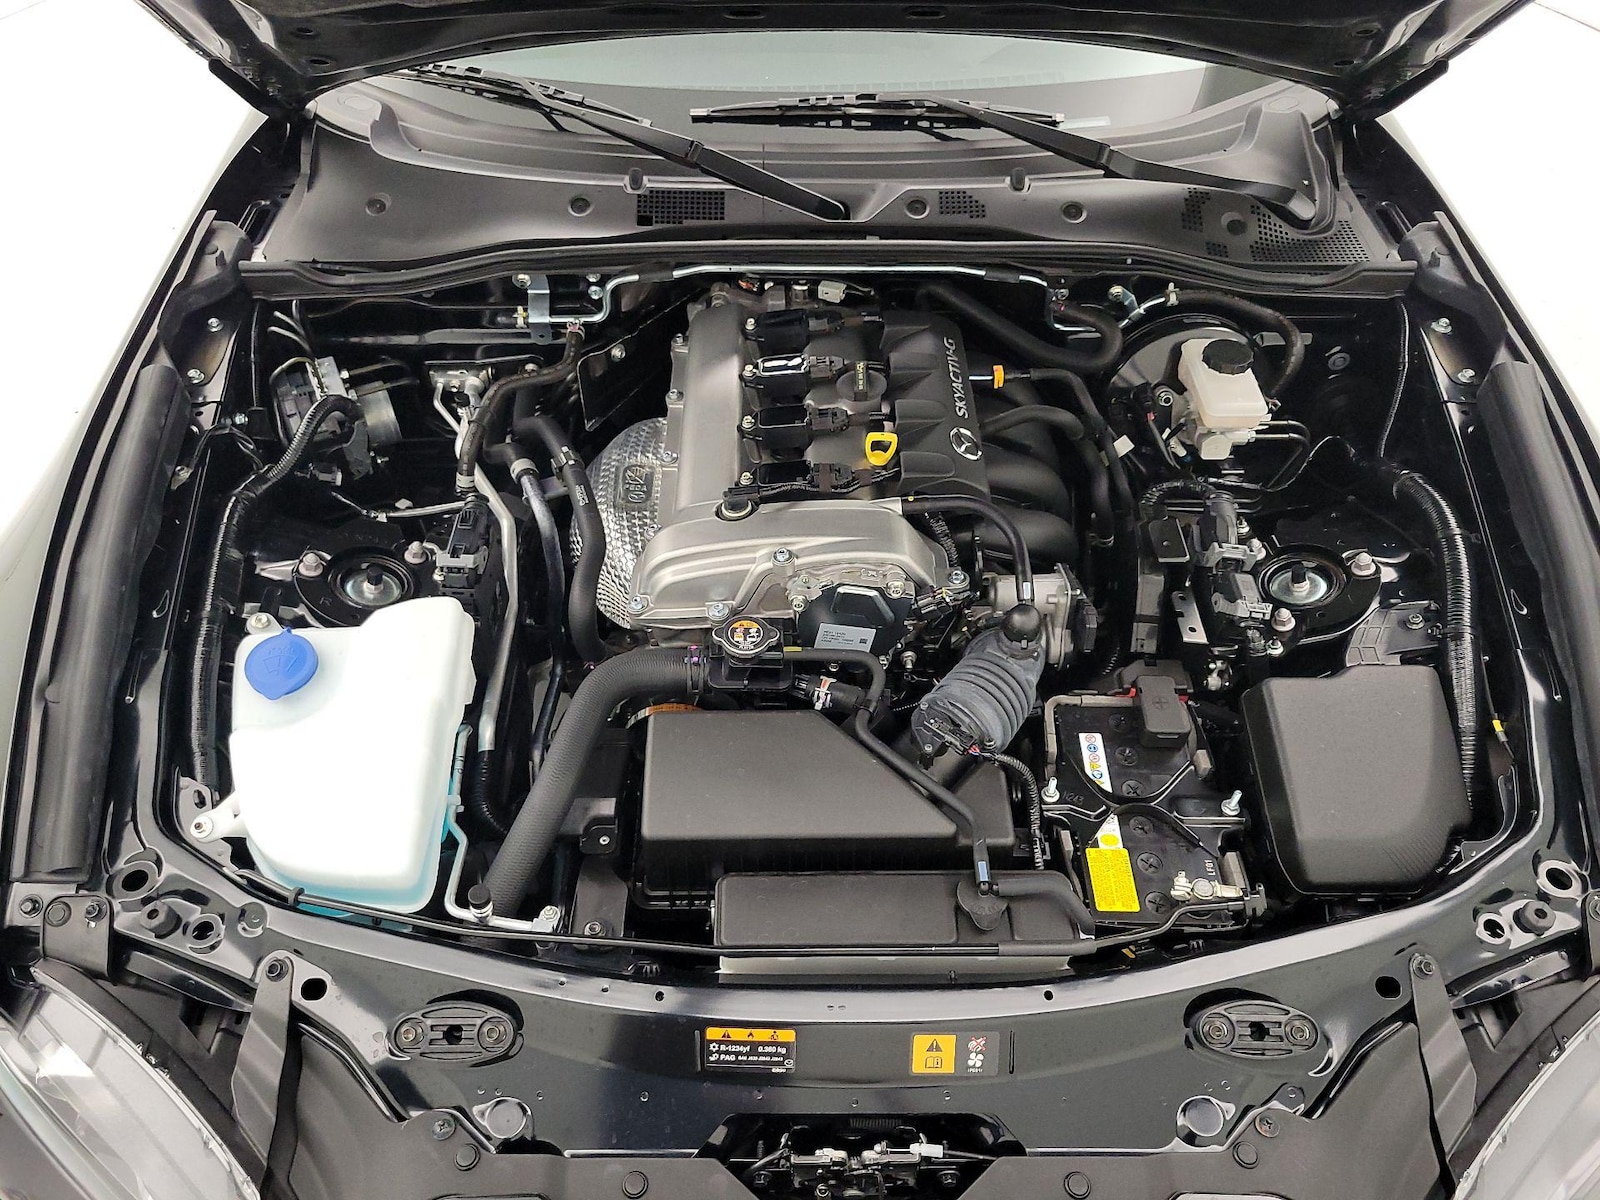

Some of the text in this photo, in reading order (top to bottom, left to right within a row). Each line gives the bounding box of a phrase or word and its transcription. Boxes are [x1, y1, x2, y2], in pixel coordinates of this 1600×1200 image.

[943, 336, 969, 419] SKYACTIV-G
[720, 1044, 750, 1053] R-1234yf
[777, 1046, 787, 1054] kg
